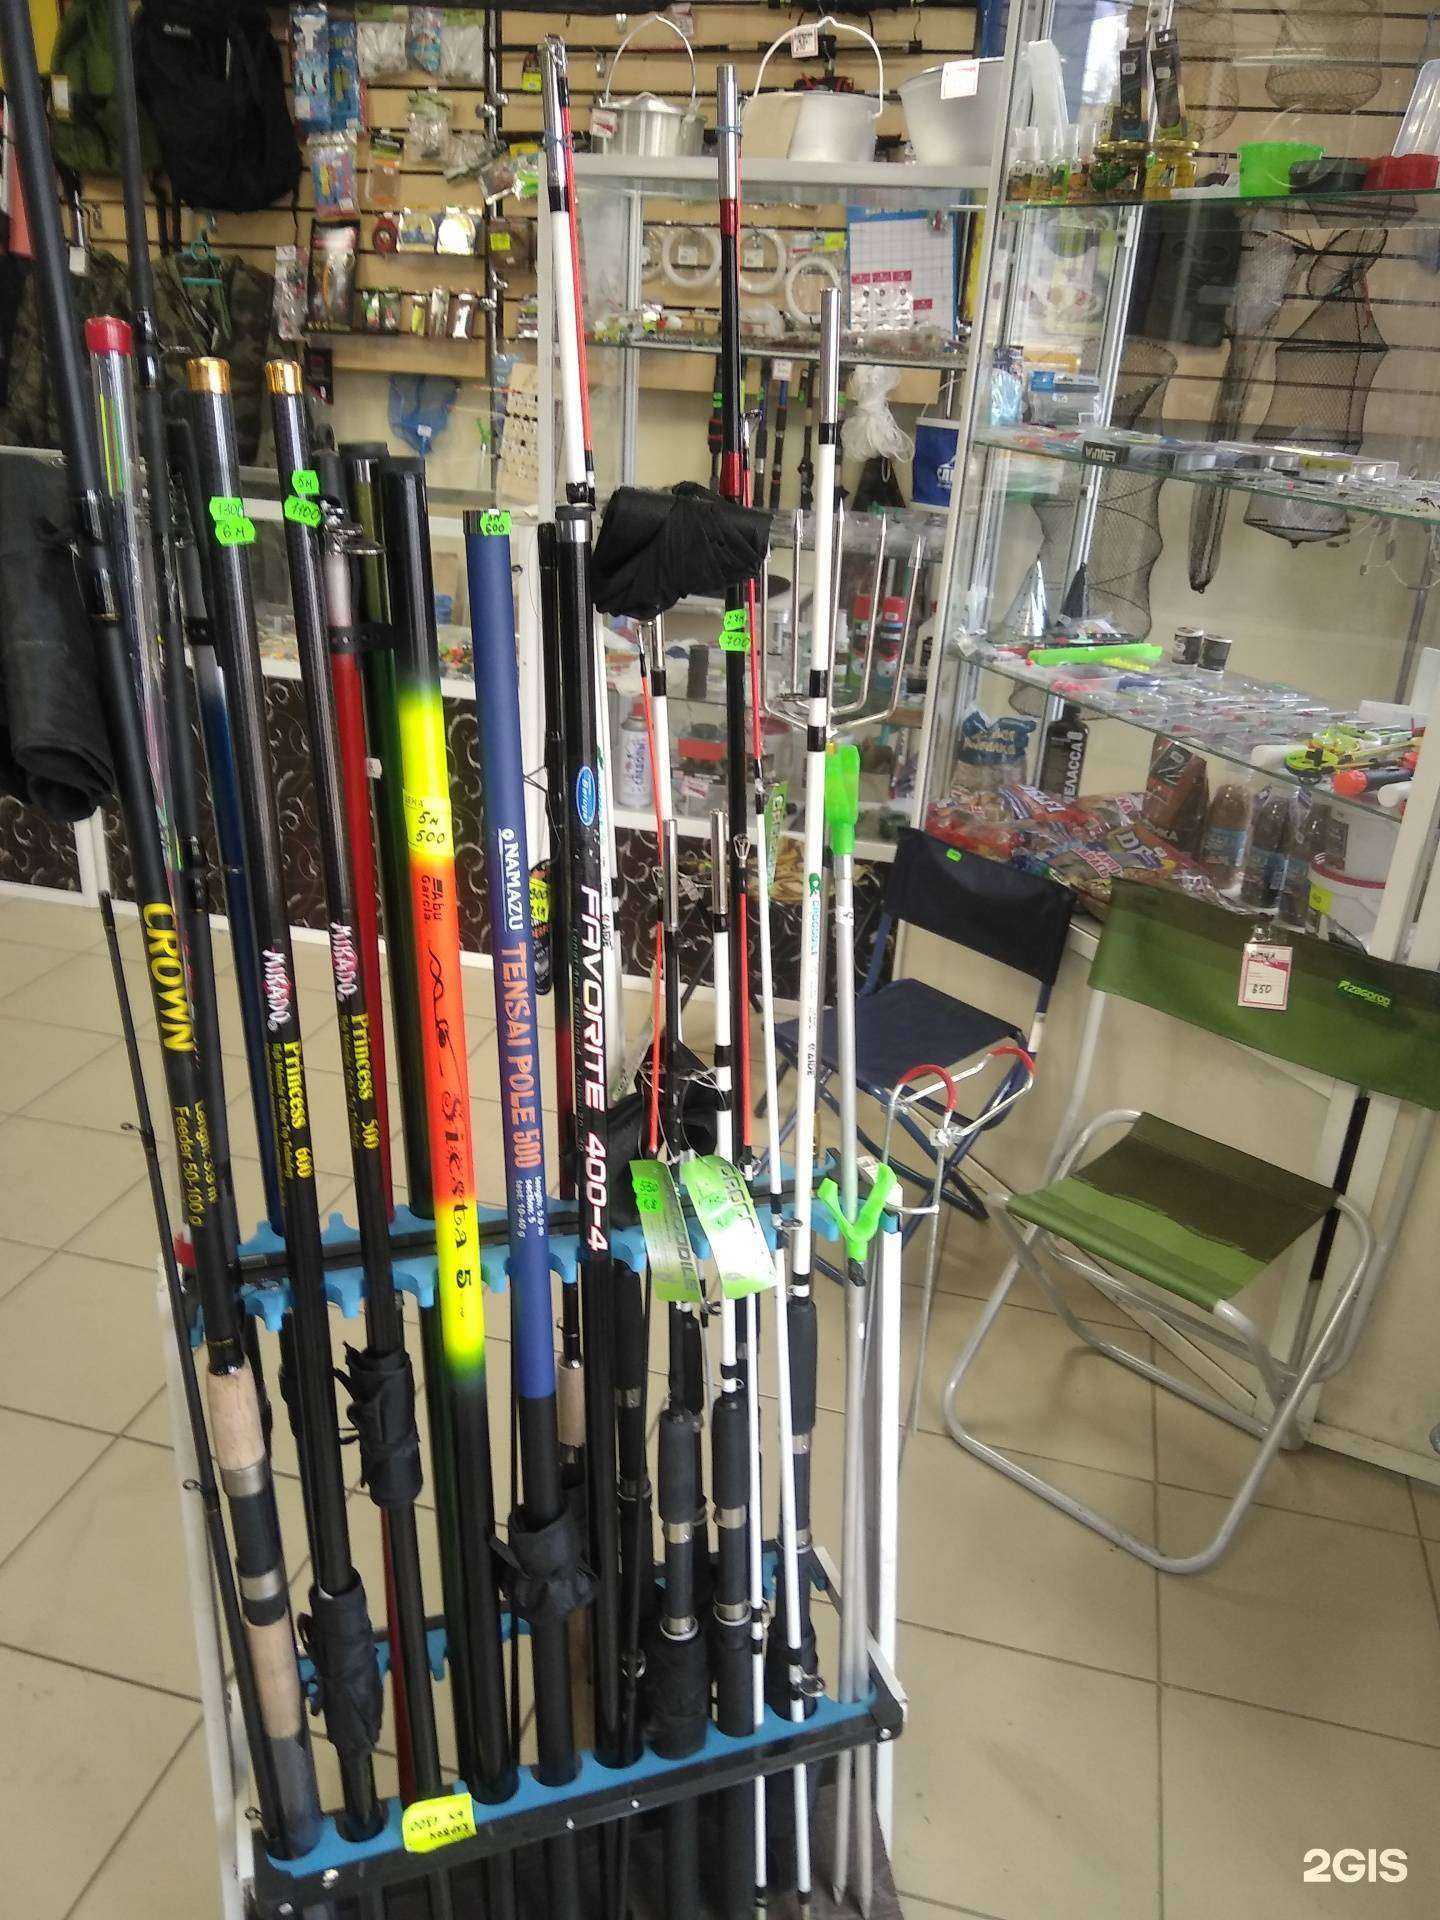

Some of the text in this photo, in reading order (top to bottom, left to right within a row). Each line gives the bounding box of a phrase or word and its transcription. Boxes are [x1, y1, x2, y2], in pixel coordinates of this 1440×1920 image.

[416, 830, 446, 844] 500
[504, 843, 525, 931] NAMAZU
[143, 902, 198, 1053] CROWN
[284, 1041, 307, 1130] Princess
[351, 1012, 380, 1150] Princess 500
[501, 941, 542, 1169] TENSAI POLE 500
[581, 884, 608, 1251] FAVORITE 400-4
[174, 1106, 194, 1161] Feeder
[456, 1268, 472, 1289] 5
